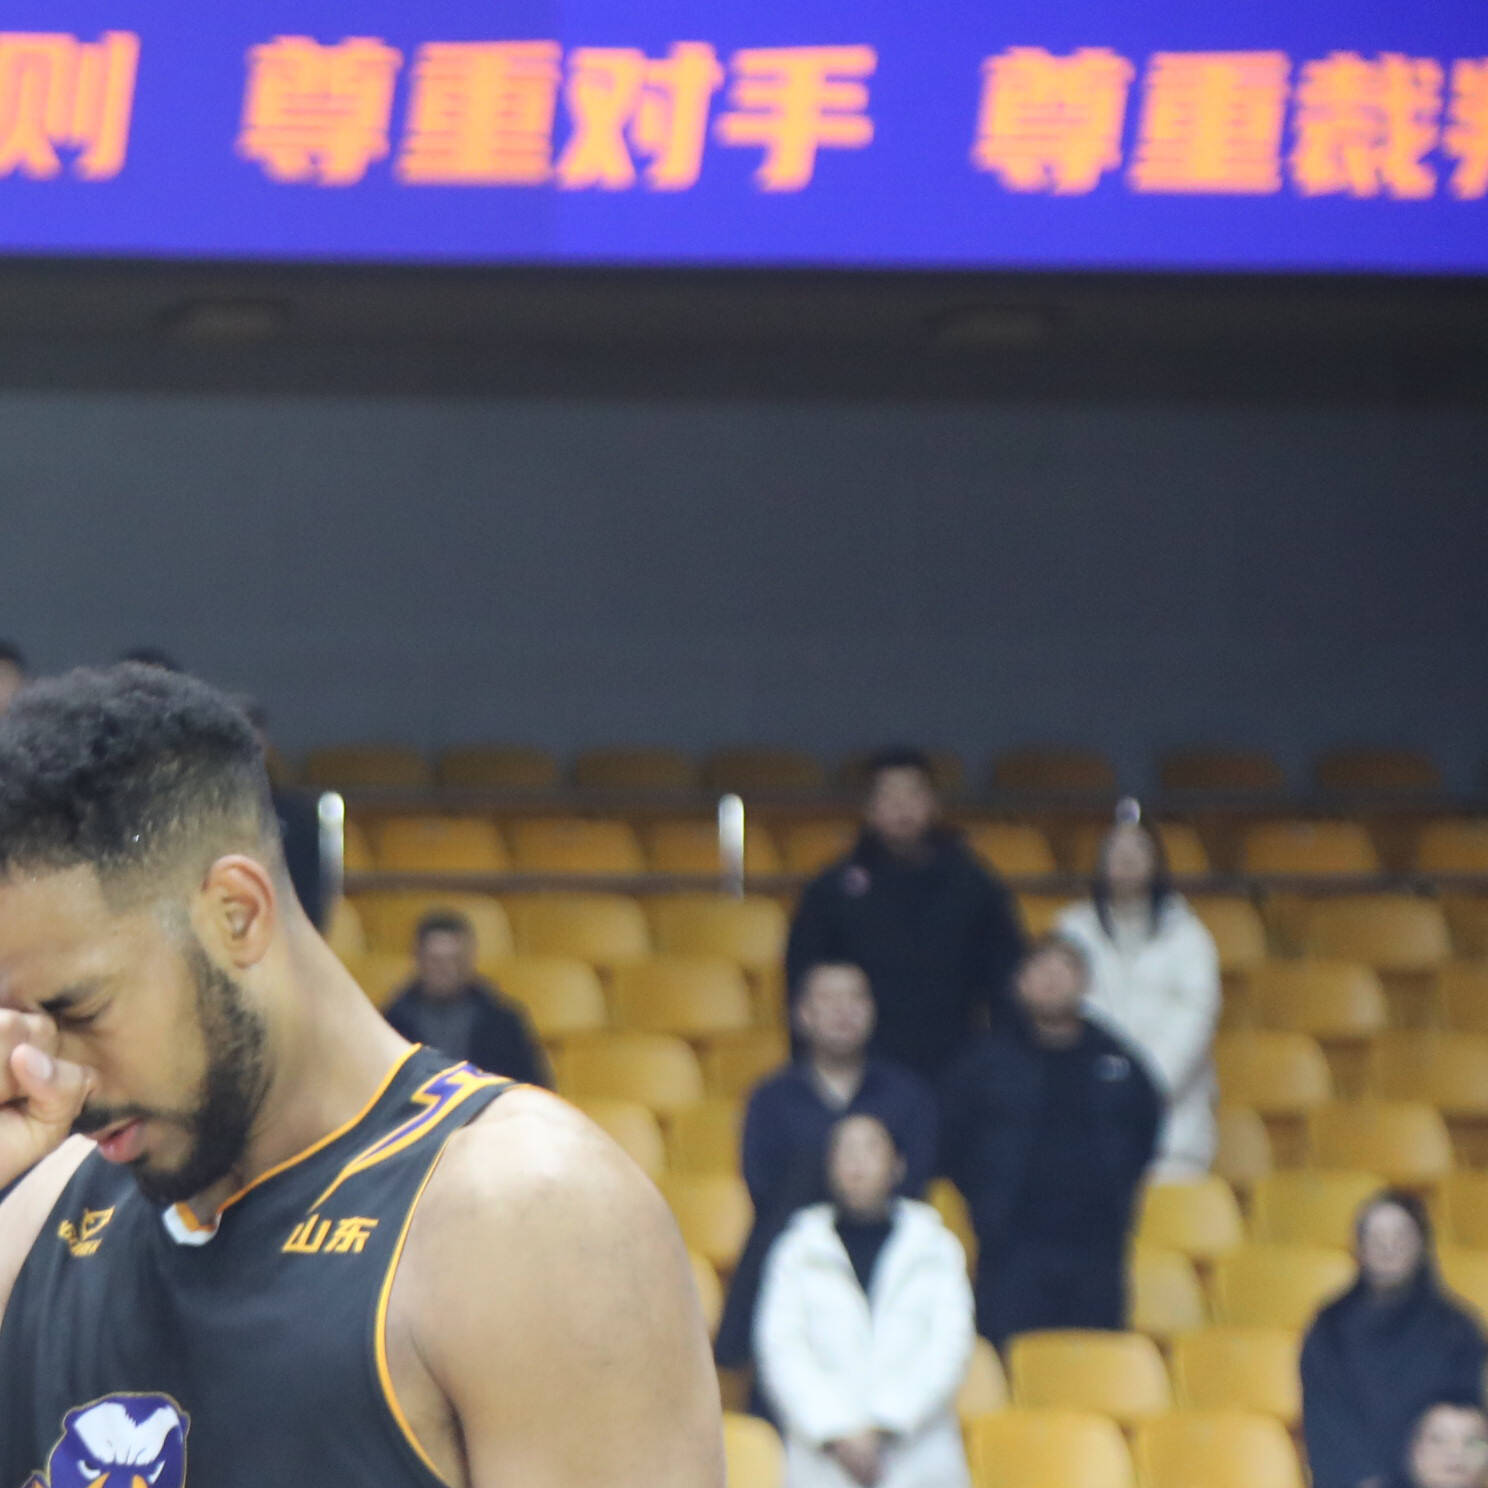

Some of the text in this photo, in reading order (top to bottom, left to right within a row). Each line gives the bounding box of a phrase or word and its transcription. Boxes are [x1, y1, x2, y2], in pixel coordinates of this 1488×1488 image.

[238, 35, 878, 190] 尊重对手
[972, 46, 1488, 198] 尊重裁
[281, 1213, 380, 1254] 山东
